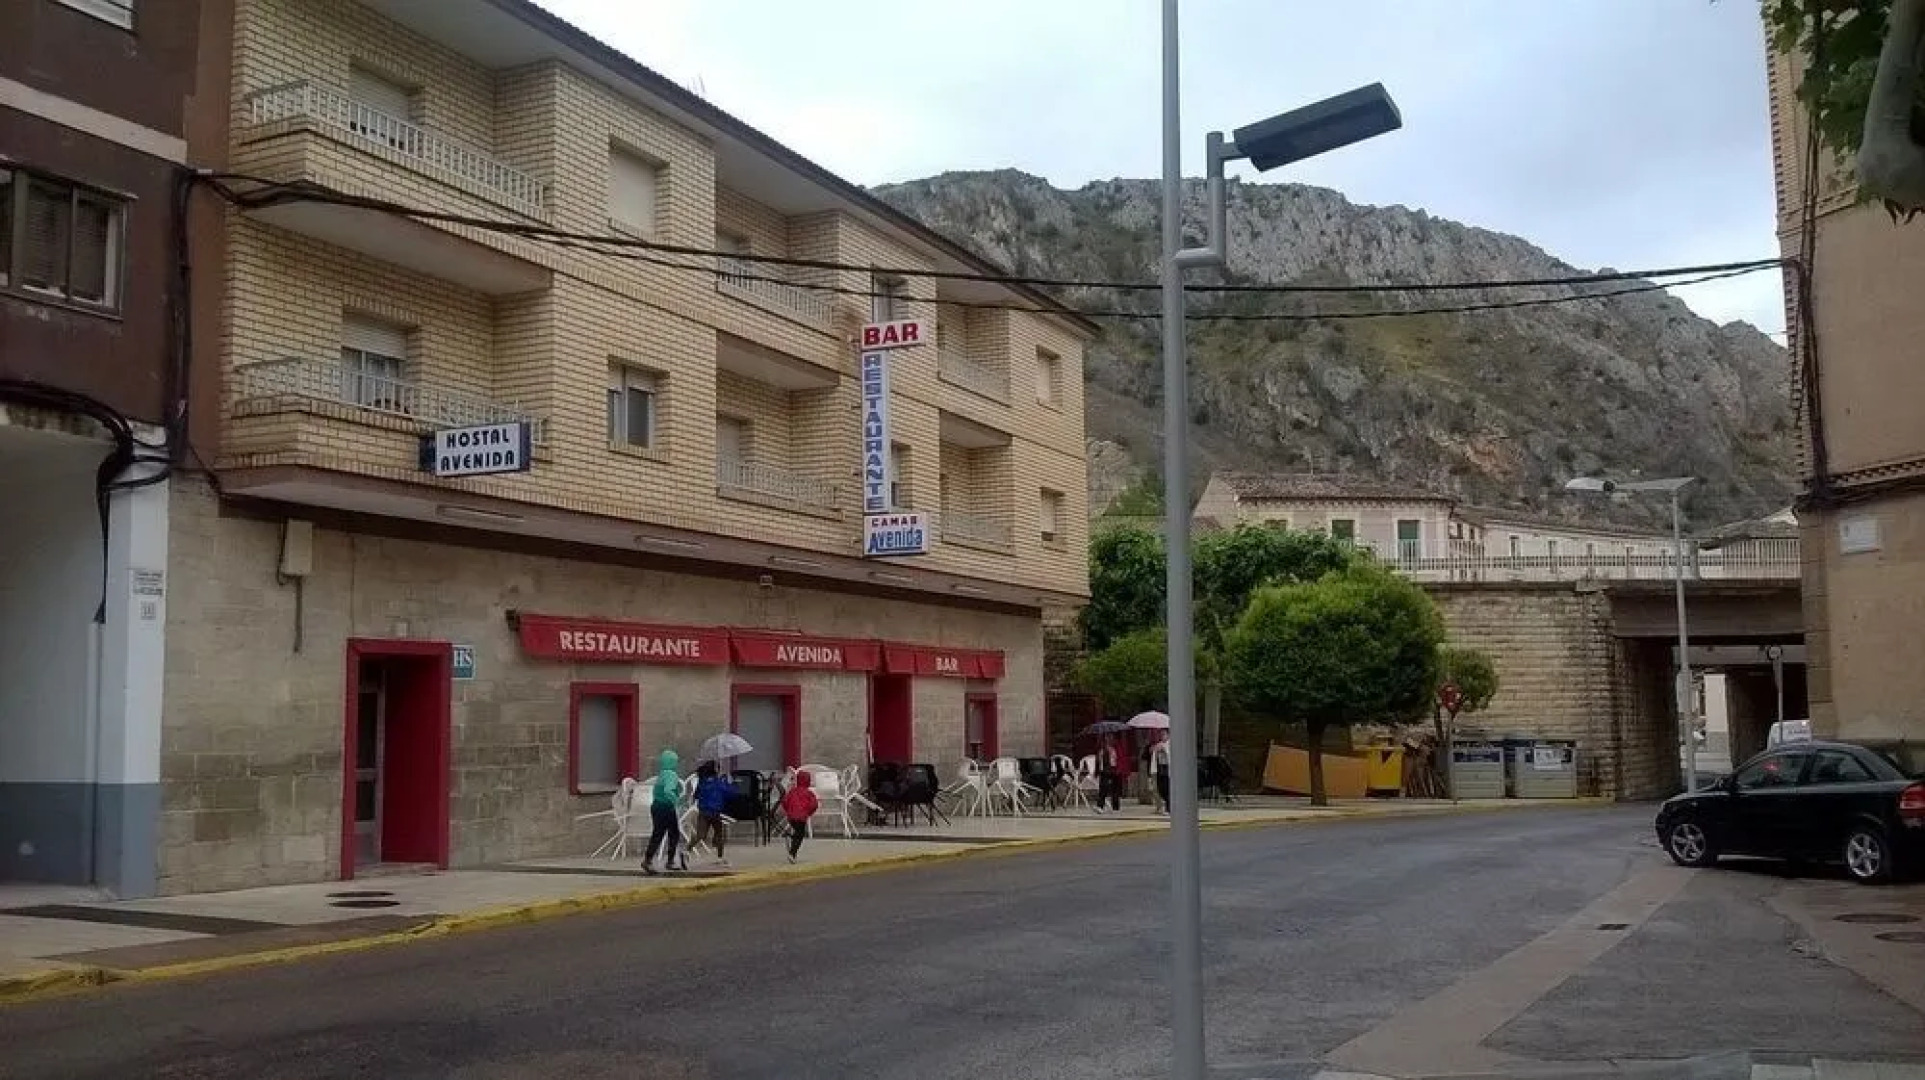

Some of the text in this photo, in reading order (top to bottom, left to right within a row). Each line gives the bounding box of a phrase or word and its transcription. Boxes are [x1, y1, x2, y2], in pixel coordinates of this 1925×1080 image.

[864, 322, 919, 346] BAR
[446, 429, 510, 449] HOSTAL
[863, 353, 884, 511] RESTAURANTE
[441, 450, 515, 471] AVENIDA
[868, 527, 923, 553] Avenida
[560, 631, 700, 657] RESTAURANTE
[777, 645, 842, 663] AVENIDA
[935, 657, 958, 671] BAR
